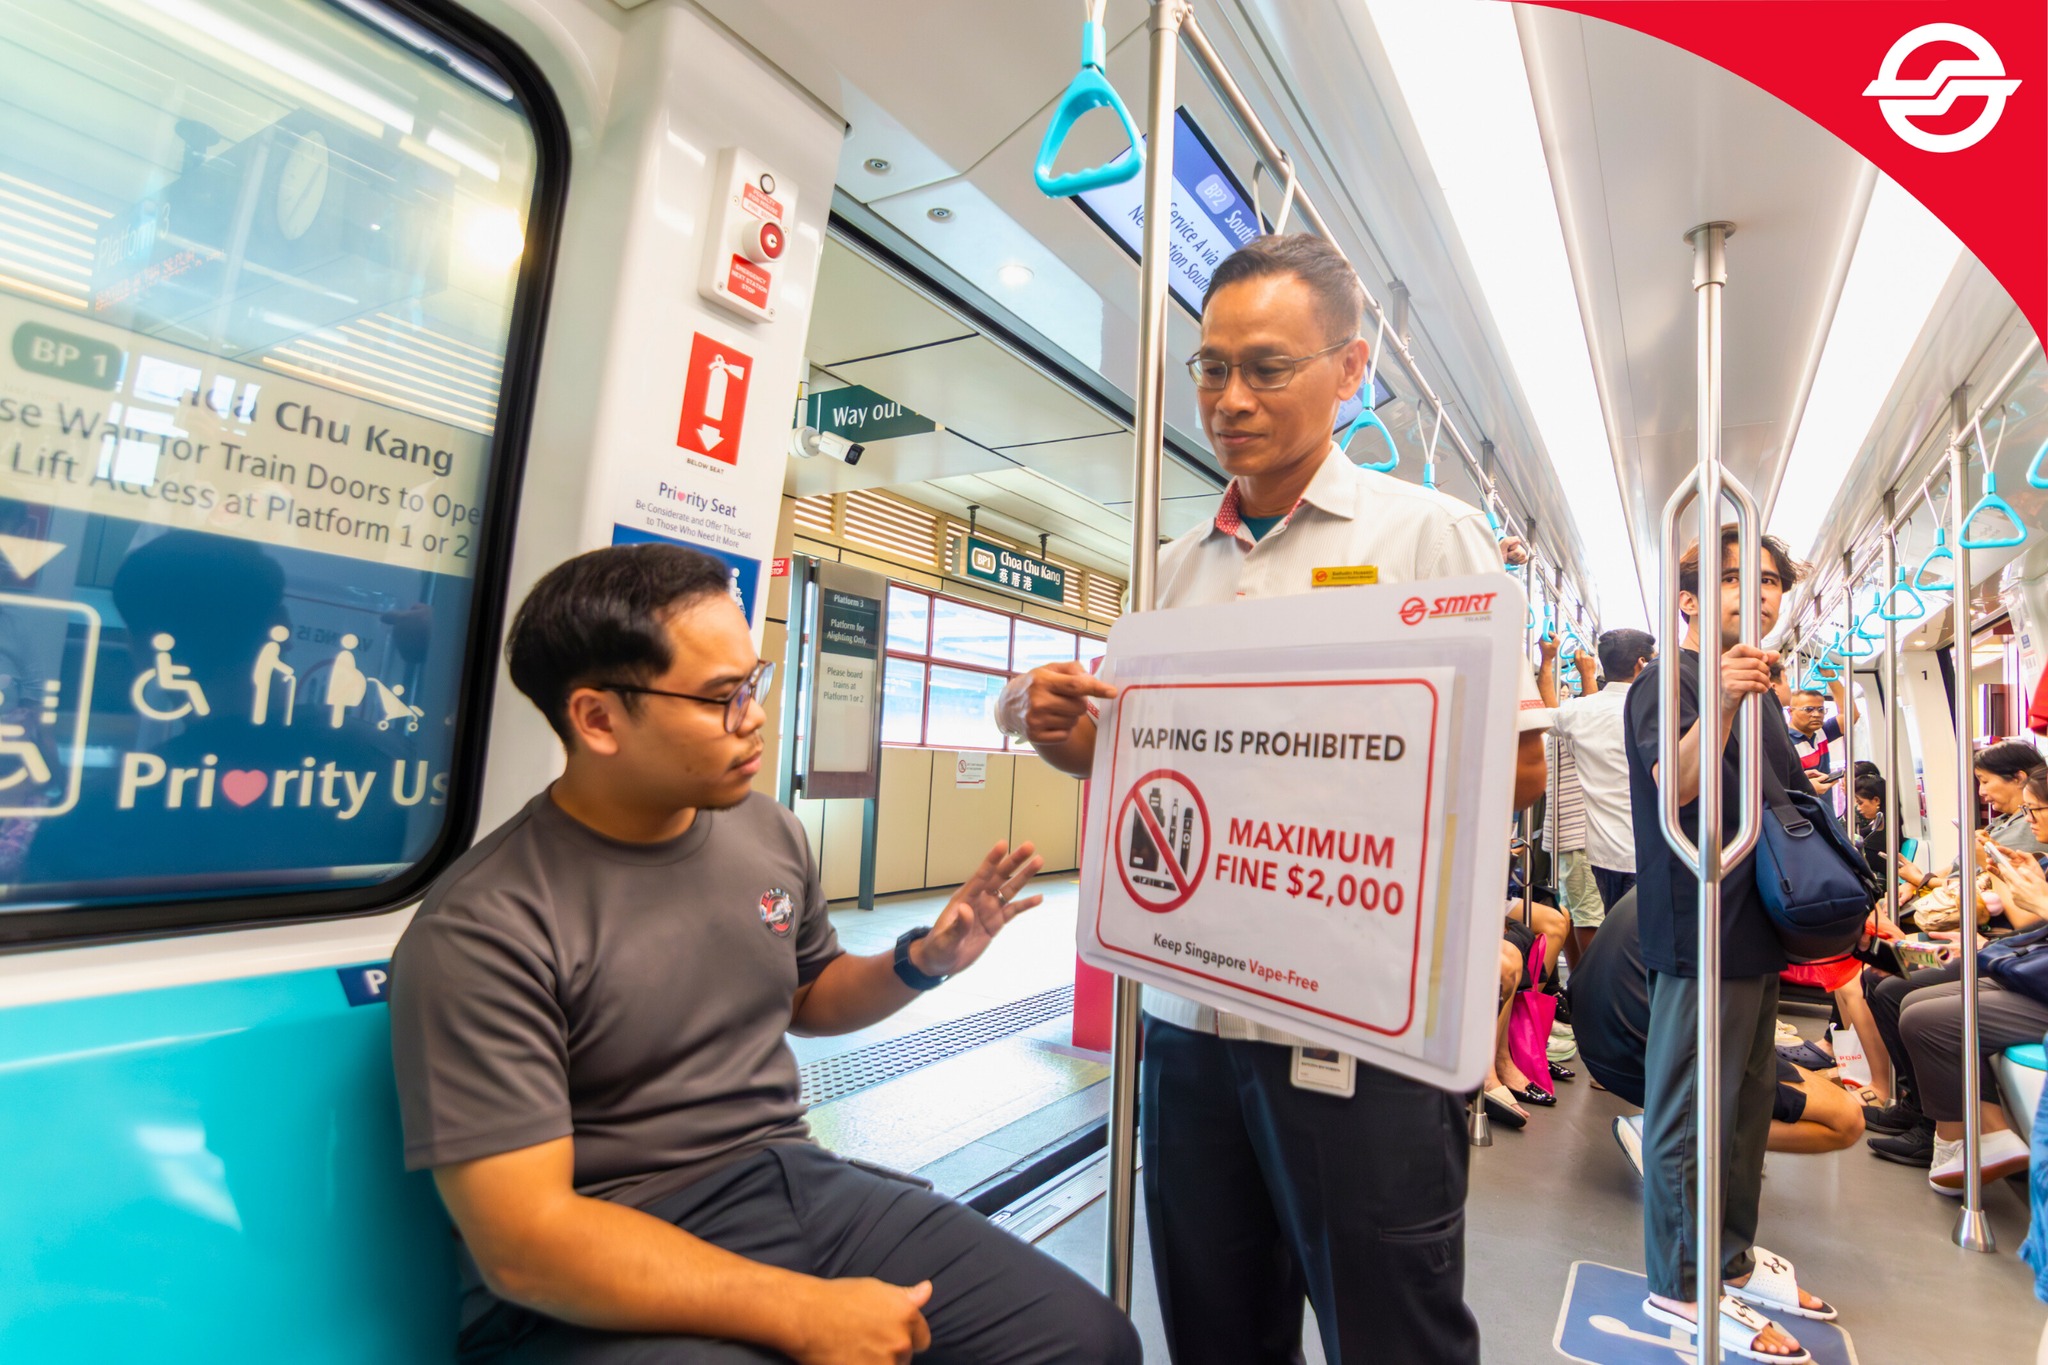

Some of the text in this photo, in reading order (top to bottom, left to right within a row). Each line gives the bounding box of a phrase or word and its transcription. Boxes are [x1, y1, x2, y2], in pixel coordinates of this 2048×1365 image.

[1204, 183, 1257, 245] BP2 South
[1192, 239, 1208, 252] A
[1201, 248, 1219, 266] via
[741, 283, 756, 295] STOP
[30, 333, 108, 378] BP 1
[833, 405, 868, 429] Way
[275, 401, 351, 446] Chu
[364, 425, 454, 477] Kang
[220, 441, 297, 485] Train
[306, 463, 391, 506] Doors
[398, 487, 425, 512] to
[686, 457, 724, 475] BELOW SEAT
[11, 442, 79, 483] Lift
[224, 490, 257, 518] at
[266, 495, 390, 544] Platform
[400, 524, 413, 548] 1
[422, 534, 449, 554] or
[453, 534, 469, 559] 2
[711, 498, 737, 518] Seat
[635, 499, 751, 540] Be Considerate and Offer This Seat
[646, 516, 740, 549] to Those Who Need It More
[977, 551, 1061, 586] BP1 Choa Chu Kang
[834, 594, 859, 607] Platform
[1429, 592, 1498, 615] SMRT
[827, 631, 867, 646] Alighting Only
[830, 618, 865, 632] Platform for
[827, 667, 864, 679] Please board
[833, 680, 857, 690] trains at
[823, 691, 849, 701] Platform
[1131, 727, 1406, 762] VAPING IS PROHIBITED
[1228, 817, 1395, 869] MAXIMUM
[1214, 853, 1405, 916] FINE $2,000
[1153, 932, 1319, 994] Keep Singapore Vape-Free
